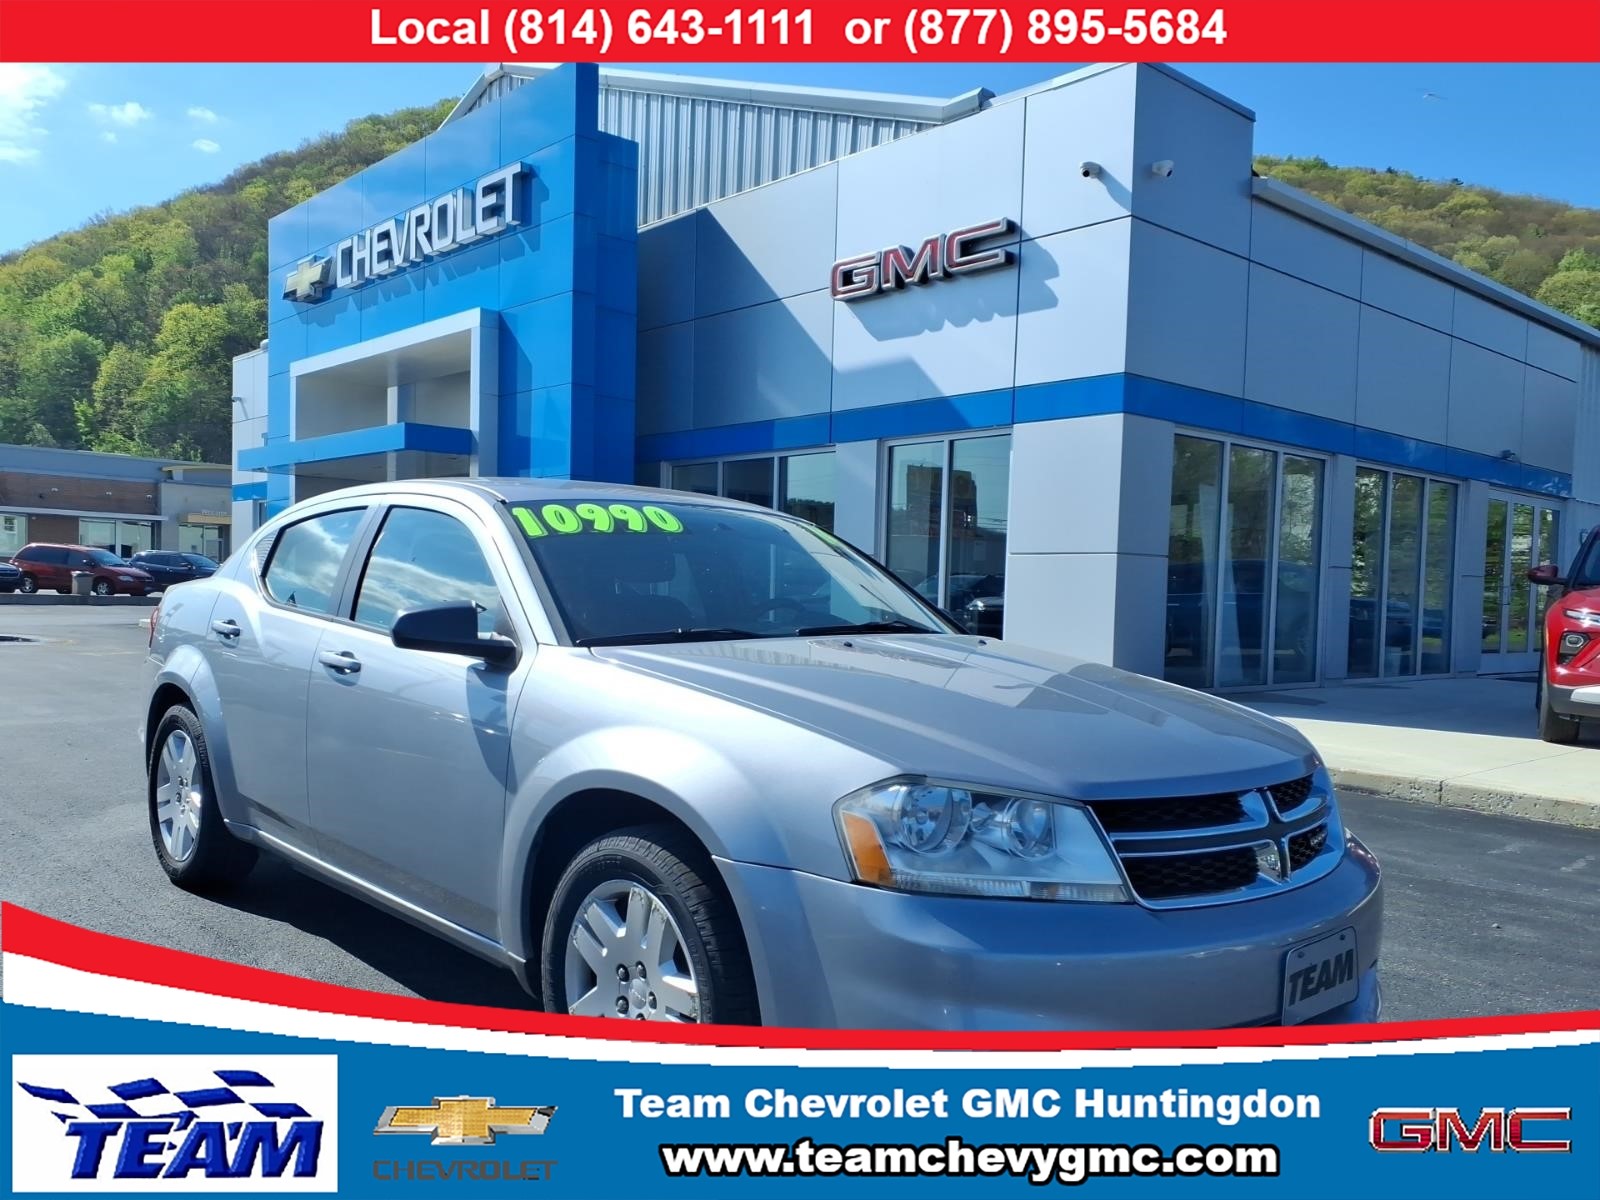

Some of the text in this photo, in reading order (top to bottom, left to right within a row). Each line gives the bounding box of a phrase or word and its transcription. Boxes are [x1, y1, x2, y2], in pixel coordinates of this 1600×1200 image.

[336, 160, 528, 288] CHEVROLET
[830, 216, 1014, 302] GMC
[511, 503, 684, 538] 10990
[1287, 948, 1355, 1007] TEAM
